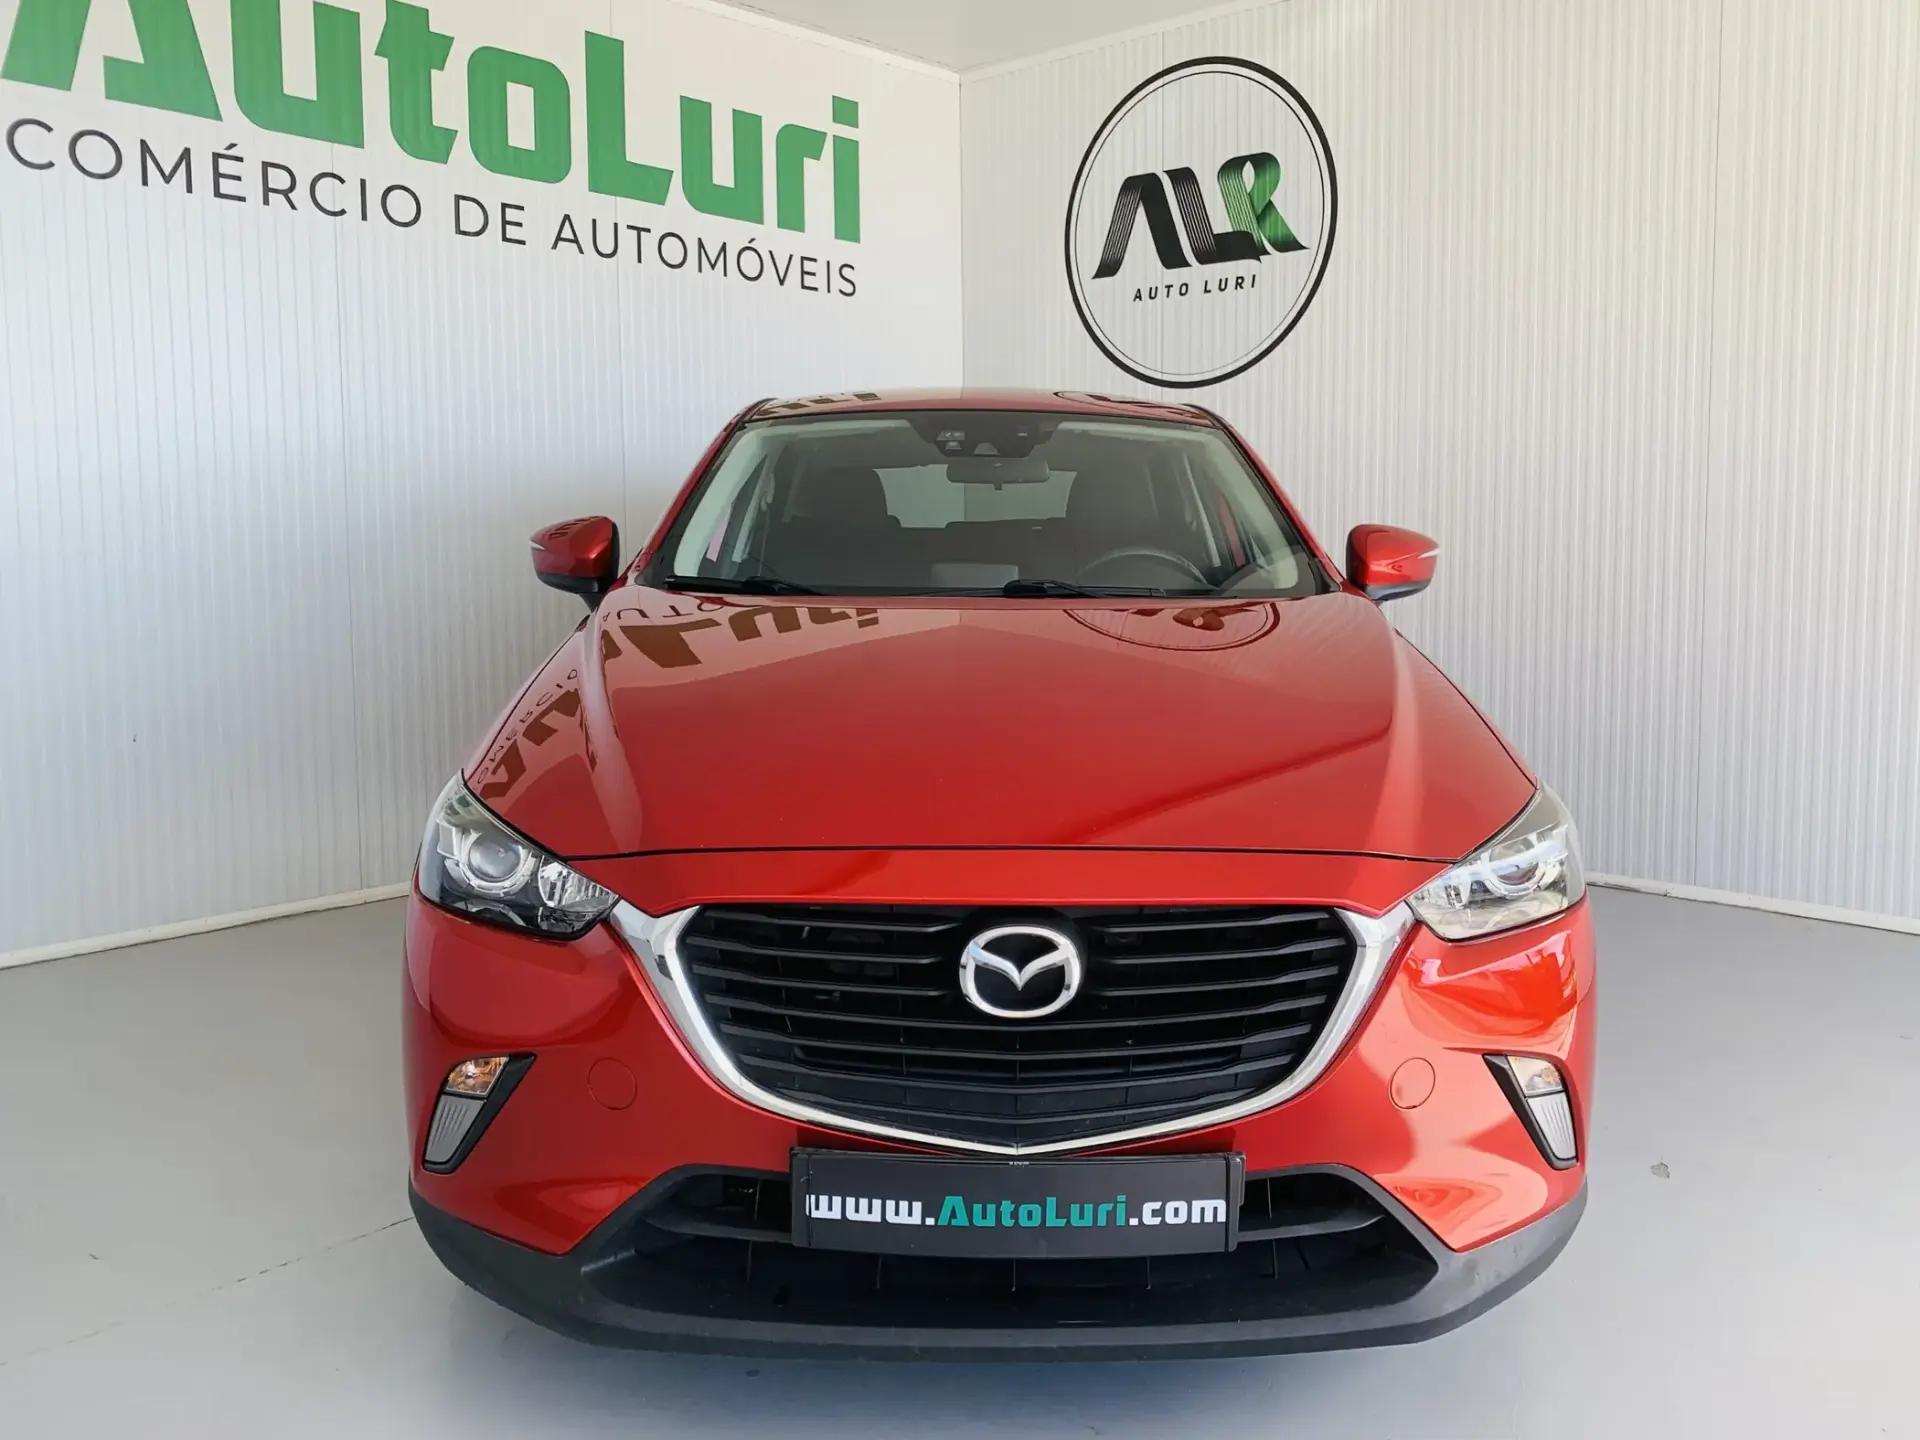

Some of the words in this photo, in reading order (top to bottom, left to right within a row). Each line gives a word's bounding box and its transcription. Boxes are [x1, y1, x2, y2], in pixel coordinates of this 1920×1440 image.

[6, 119, 422, 228] COMÉRCIO
[453, 194, 527, 246] DE
[550, 214, 857, 298] AUTOMÓVEIS
[1133, 283, 1189, 302] AUTO
[1203, 274, 1257, 294] LURI
[806, 1194, 1227, 1227] www.AutoLuri.com
